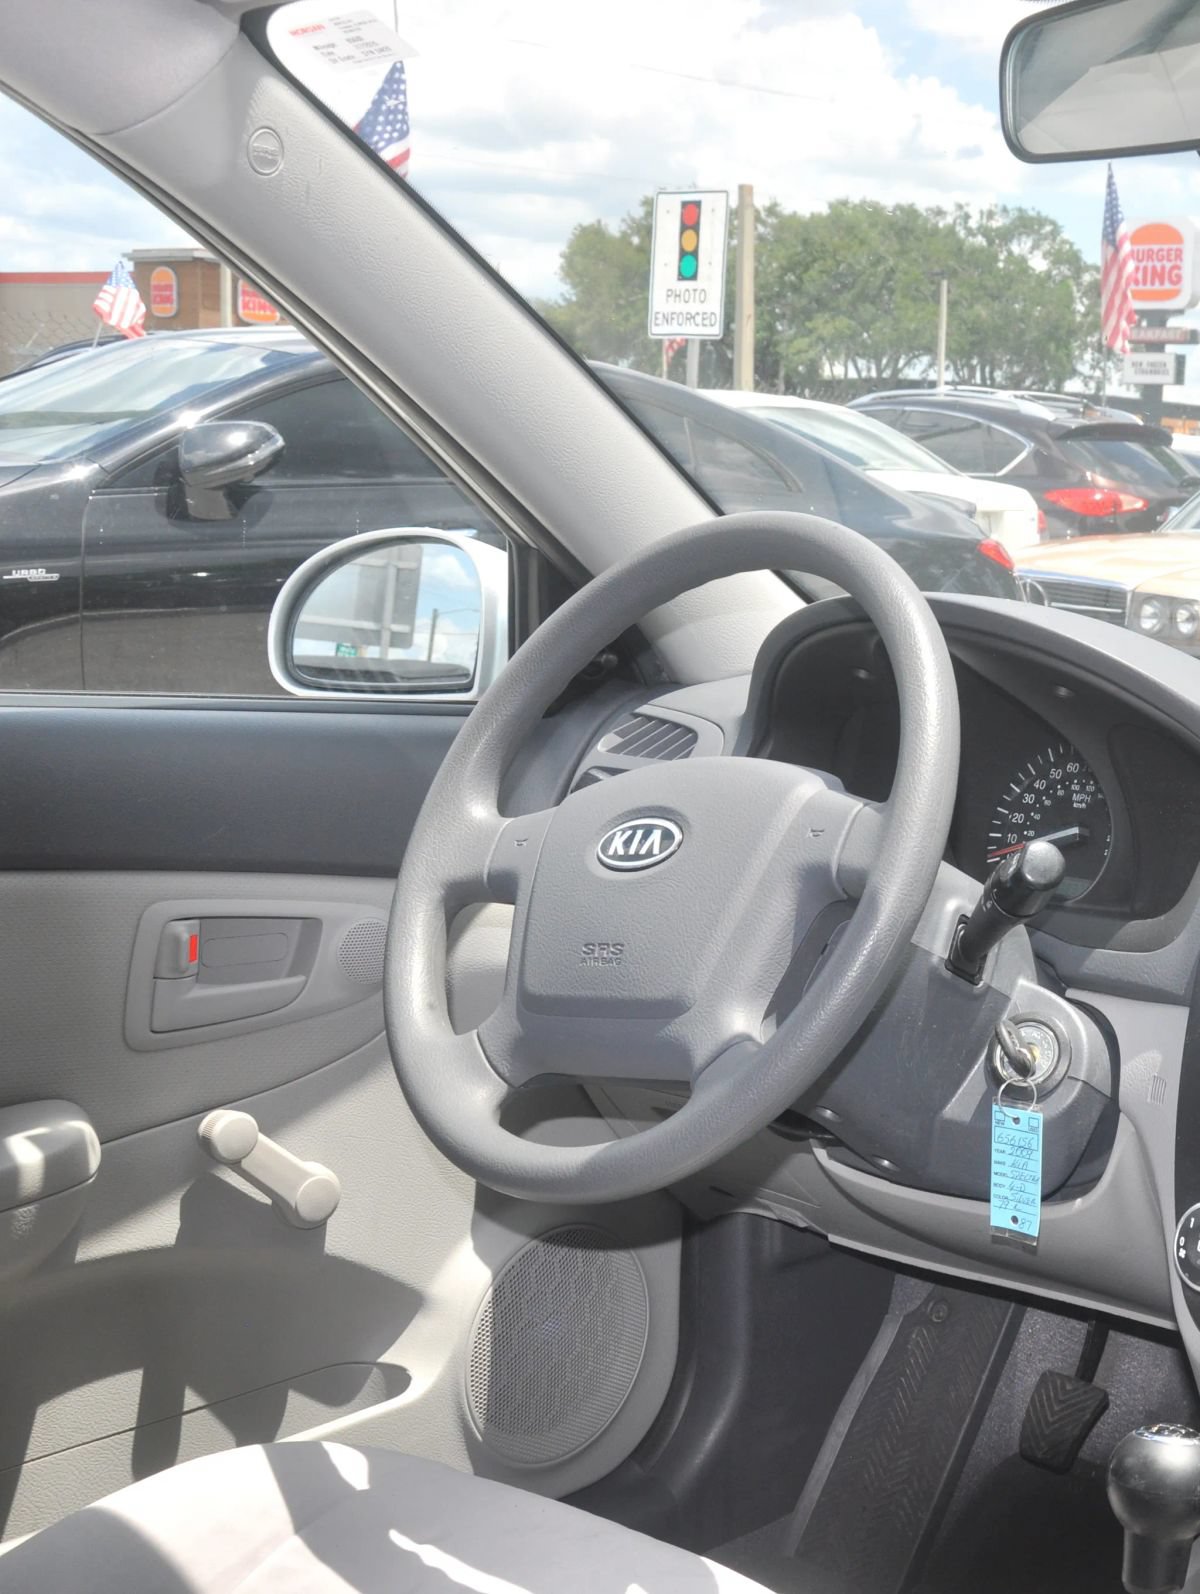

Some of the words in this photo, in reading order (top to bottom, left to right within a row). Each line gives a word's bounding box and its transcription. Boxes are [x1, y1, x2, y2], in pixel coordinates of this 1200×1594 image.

[1131, 247, 1183, 263] URGER
[666, 288, 707, 304] PHOTO
[654, 311, 718, 327] ENFORCED
[1067, 762, 1080, 773] 60
[1049, 769, 1062, 779] 50
[1033, 780, 1046, 790] 40
[1022, 793, 1035, 804] 30
[1072, 793, 1091, 803] MPH
[1012, 813, 1024, 824] 20
[608, 829, 662, 856] KIA
[1007, 833, 1017, 844] 10
[582, 942, 625, 956] SRS
[1189, 1217, 1195, 1228] 1
[1179, 1236, 1185, 1246] 0
